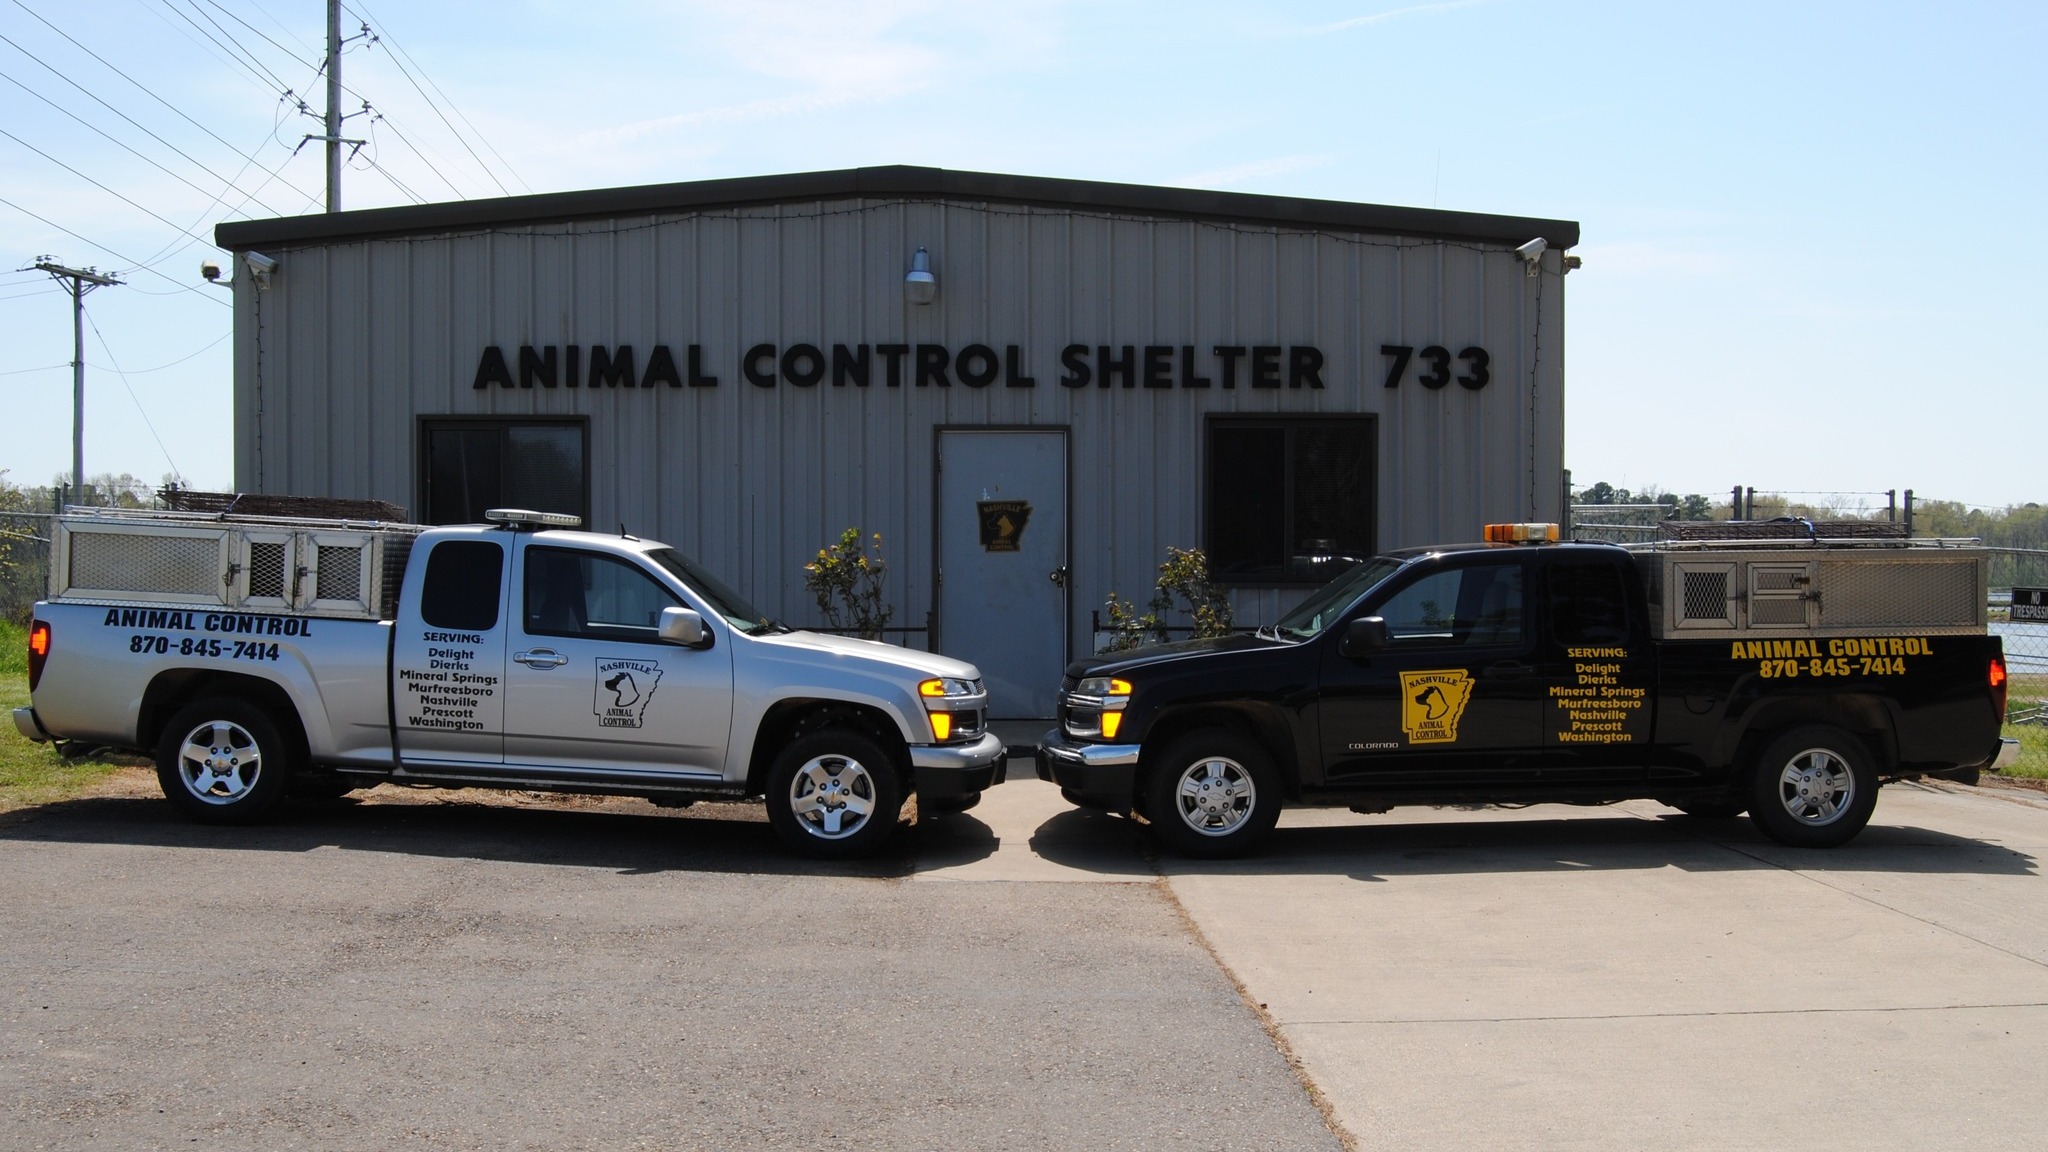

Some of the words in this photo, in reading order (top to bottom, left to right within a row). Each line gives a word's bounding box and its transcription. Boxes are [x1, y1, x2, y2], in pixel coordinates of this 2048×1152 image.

[473, 344, 718, 389] ANIMAL
[743, 343, 1035, 388] CONTROL
[1060, 344, 1325, 390] SHELTER
[1380, 344, 1491, 391] 733
[983, 504, 1021, 513] NASHVILLE
[2030, 591, 2041, 605] NO
[104, 609, 196, 631] ANIMAL
[204, 614, 312, 637] CONTROL
[423, 632, 484, 644] SERVING:
[130, 635, 280, 661] 870-845-7414
[1567, 648, 1628, 658] SERVING:
[1731, 640, 1823, 659] ANIMAL
[1828, 637, 1933, 656] CONTROL
[428, 648, 475, 661] Delight
[430, 659, 469, 671] Dierks
[600, 661, 652, 675] NASHVILLE
[1575, 663, 1621, 675] Delight
[1759, 657, 1906, 678] 870-845-7414
[400, 669, 447, 681] Mineral
[452, 672, 498, 686] Springs
[1409, 675, 1458, 689] NASHVILLE
[1578, 674, 1617, 685] Dierks
[408, 682, 494, 697] Murfreesboro
[1549, 686, 1597, 697] Mineral
[1600, 686, 1646, 699] Springs
[420, 694, 478, 708] Nashville
[1557, 698, 1642, 709] Murfreesboro
[422, 706, 474, 719] Prescott
[606, 708, 633, 717] ANIMAL
[1569, 710, 1627, 720] Nashville
[409, 716, 484, 731] Washington
[603, 717, 636, 727] CONTROL
[1418, 721, 1445, 730] ANIMAL
[1572, 721, 1623, 731] Prescott
[1415, 729, 1448, 739] CONTROL
[1558, 732, 1632, 744] Washington
[1348, 742, 1399, 750] COLORADO
